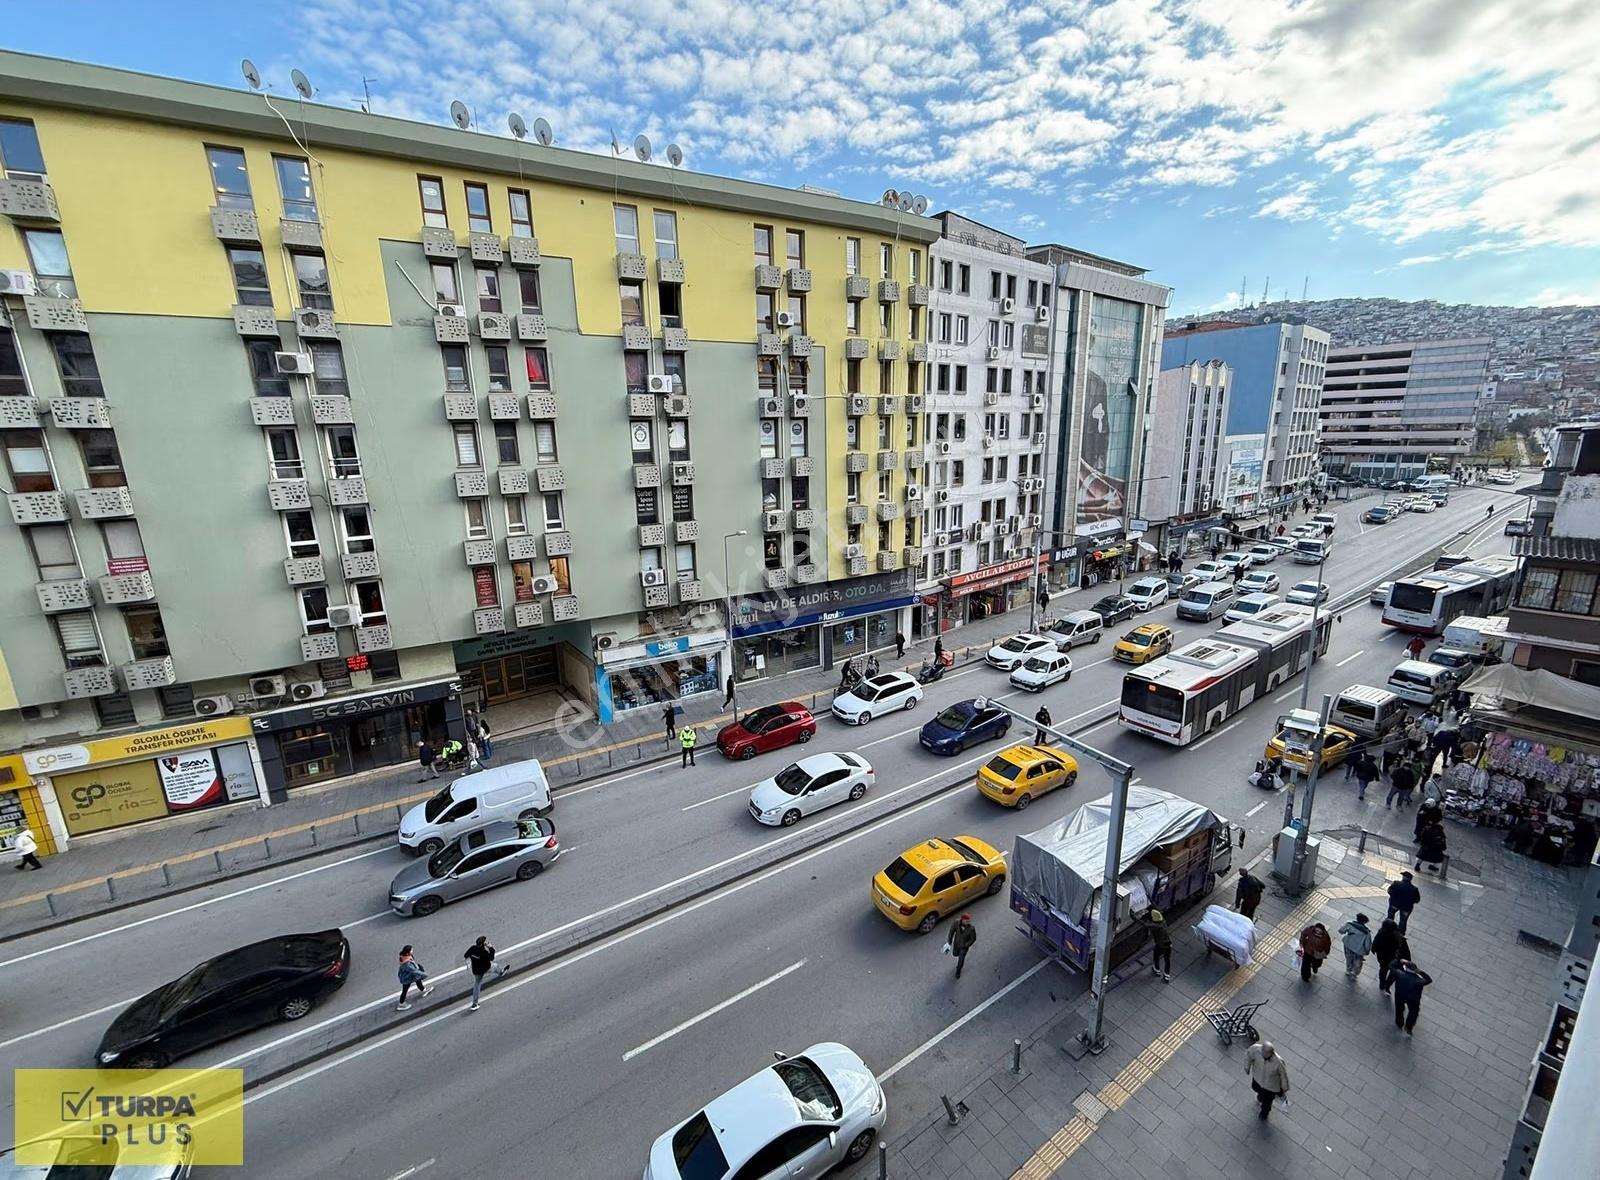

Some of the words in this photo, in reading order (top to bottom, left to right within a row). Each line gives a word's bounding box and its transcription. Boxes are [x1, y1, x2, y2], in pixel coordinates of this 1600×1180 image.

[1061, 547, 1077, 559] UĞUR
[963, 565, 1005, 582] AVCILAR
[1007, 558, 1034, 572] TOPTA
[763, 600, 778, 612] EV
[781, 597, 796, 609] DE
[845, 583, 867, 598] OTO
[657, 640, 678, 650] beko
[311, 705, 340, 719] SC
[344, 690, 415, 714] SARVIN
[124, 740, 175, 754] TRANSFER
[175, 732, 217, 745] NOKTASI
[133, 733, 173, 745] GLOBAL
[173, 727, 206, 738] ÖDEME
[179, 758, 209, 769] SAM
[118, 800, 140, 812] ria
